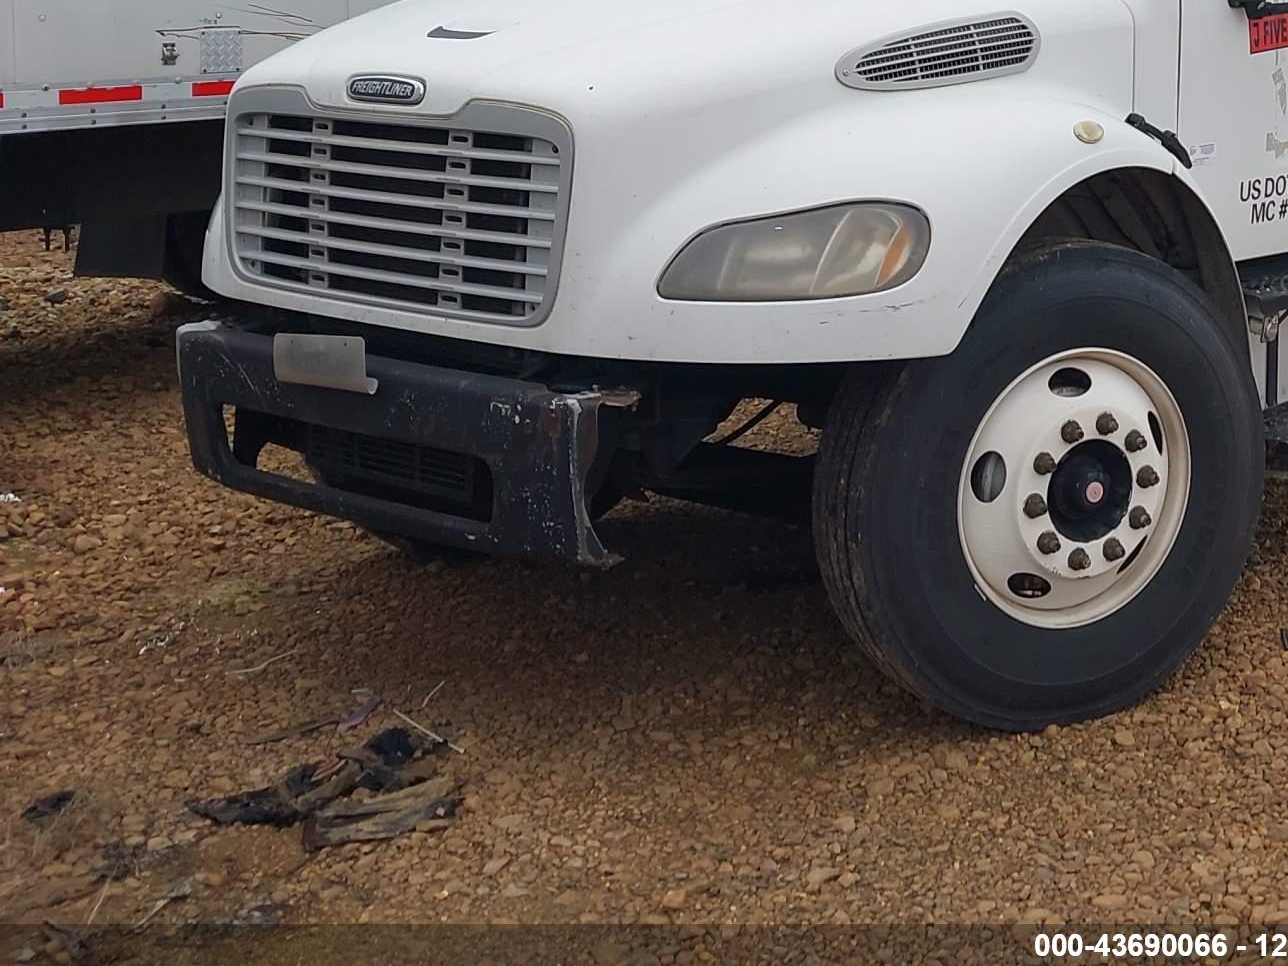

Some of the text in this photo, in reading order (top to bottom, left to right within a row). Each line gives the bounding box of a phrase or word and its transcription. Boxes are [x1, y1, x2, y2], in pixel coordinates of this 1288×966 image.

[1253, 22, 1260, 47] J
[1263, 17, 1288, 46] FIVE
[351, 81, 413, 97] FREIGHTLINER
[1240, 179, 1261, 202] US
[1251, 200, 1276, 224] MC
[1279, 198, 1288, 220] #
